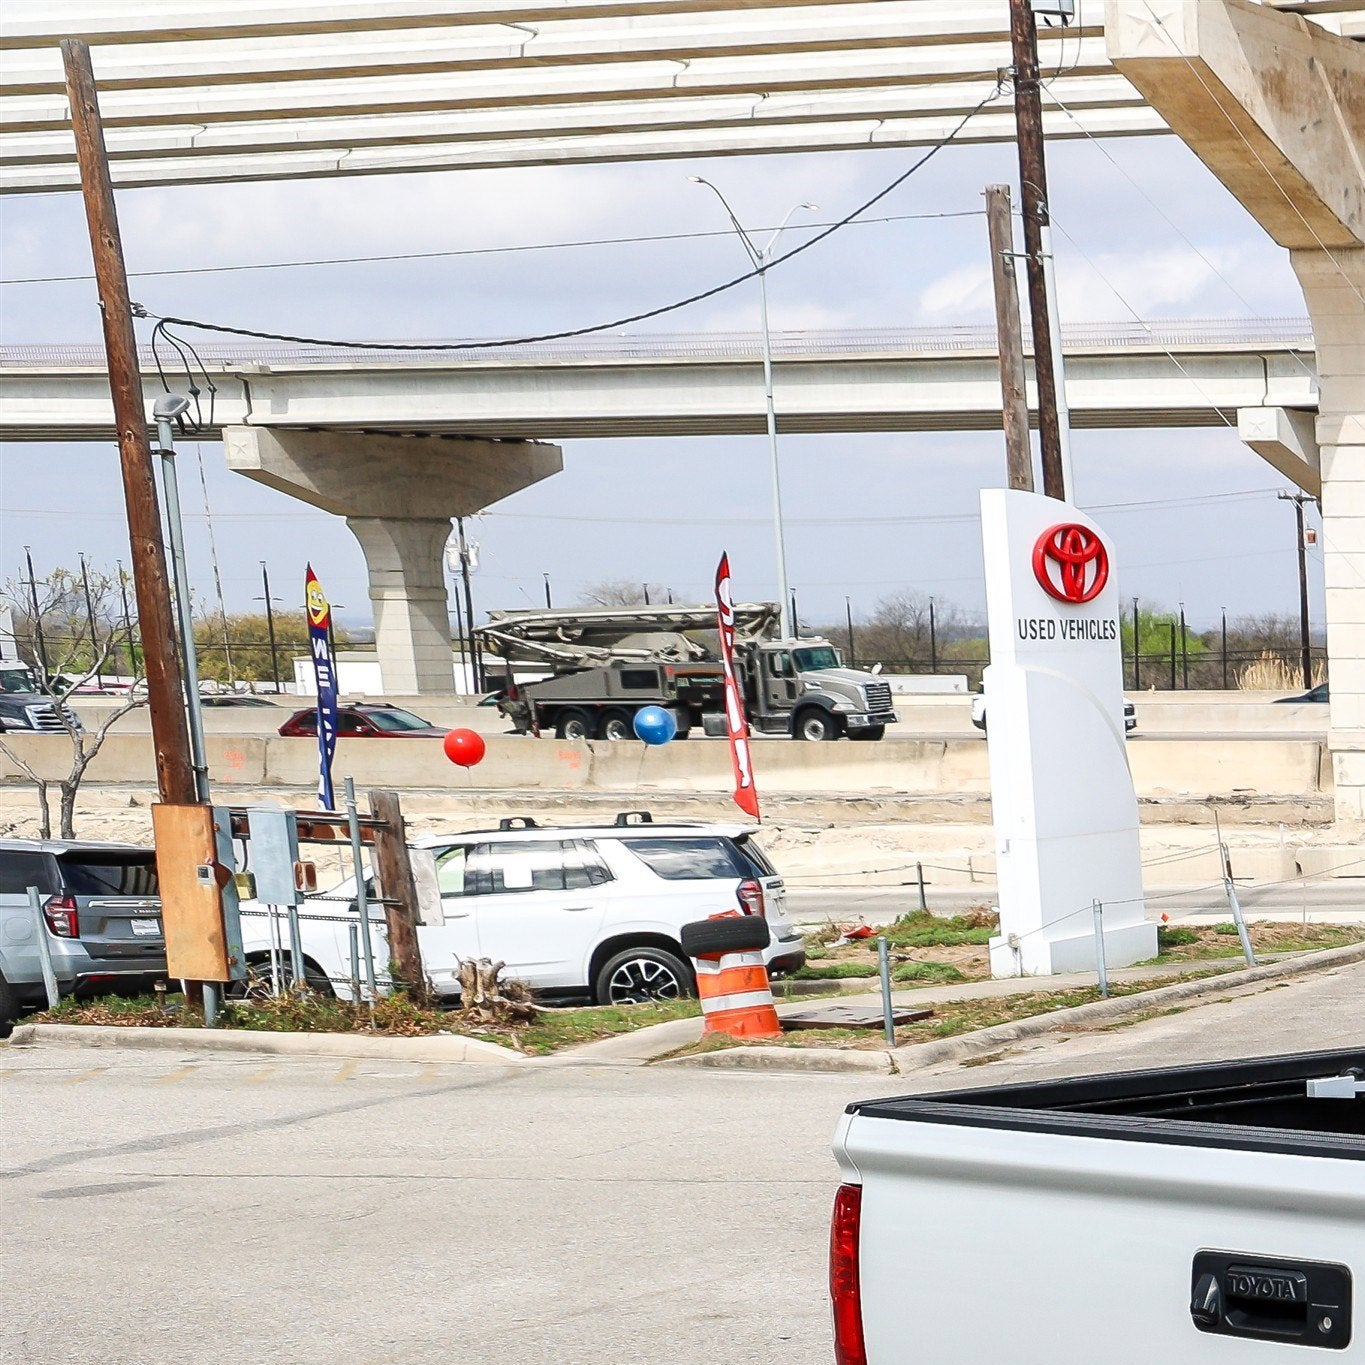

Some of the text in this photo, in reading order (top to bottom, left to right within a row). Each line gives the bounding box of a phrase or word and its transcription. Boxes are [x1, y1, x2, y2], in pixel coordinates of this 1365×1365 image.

[1018, 619, 1116, 640] USED VEHICLES
[1227, 1273, 1297, 1301] TOYOTA
